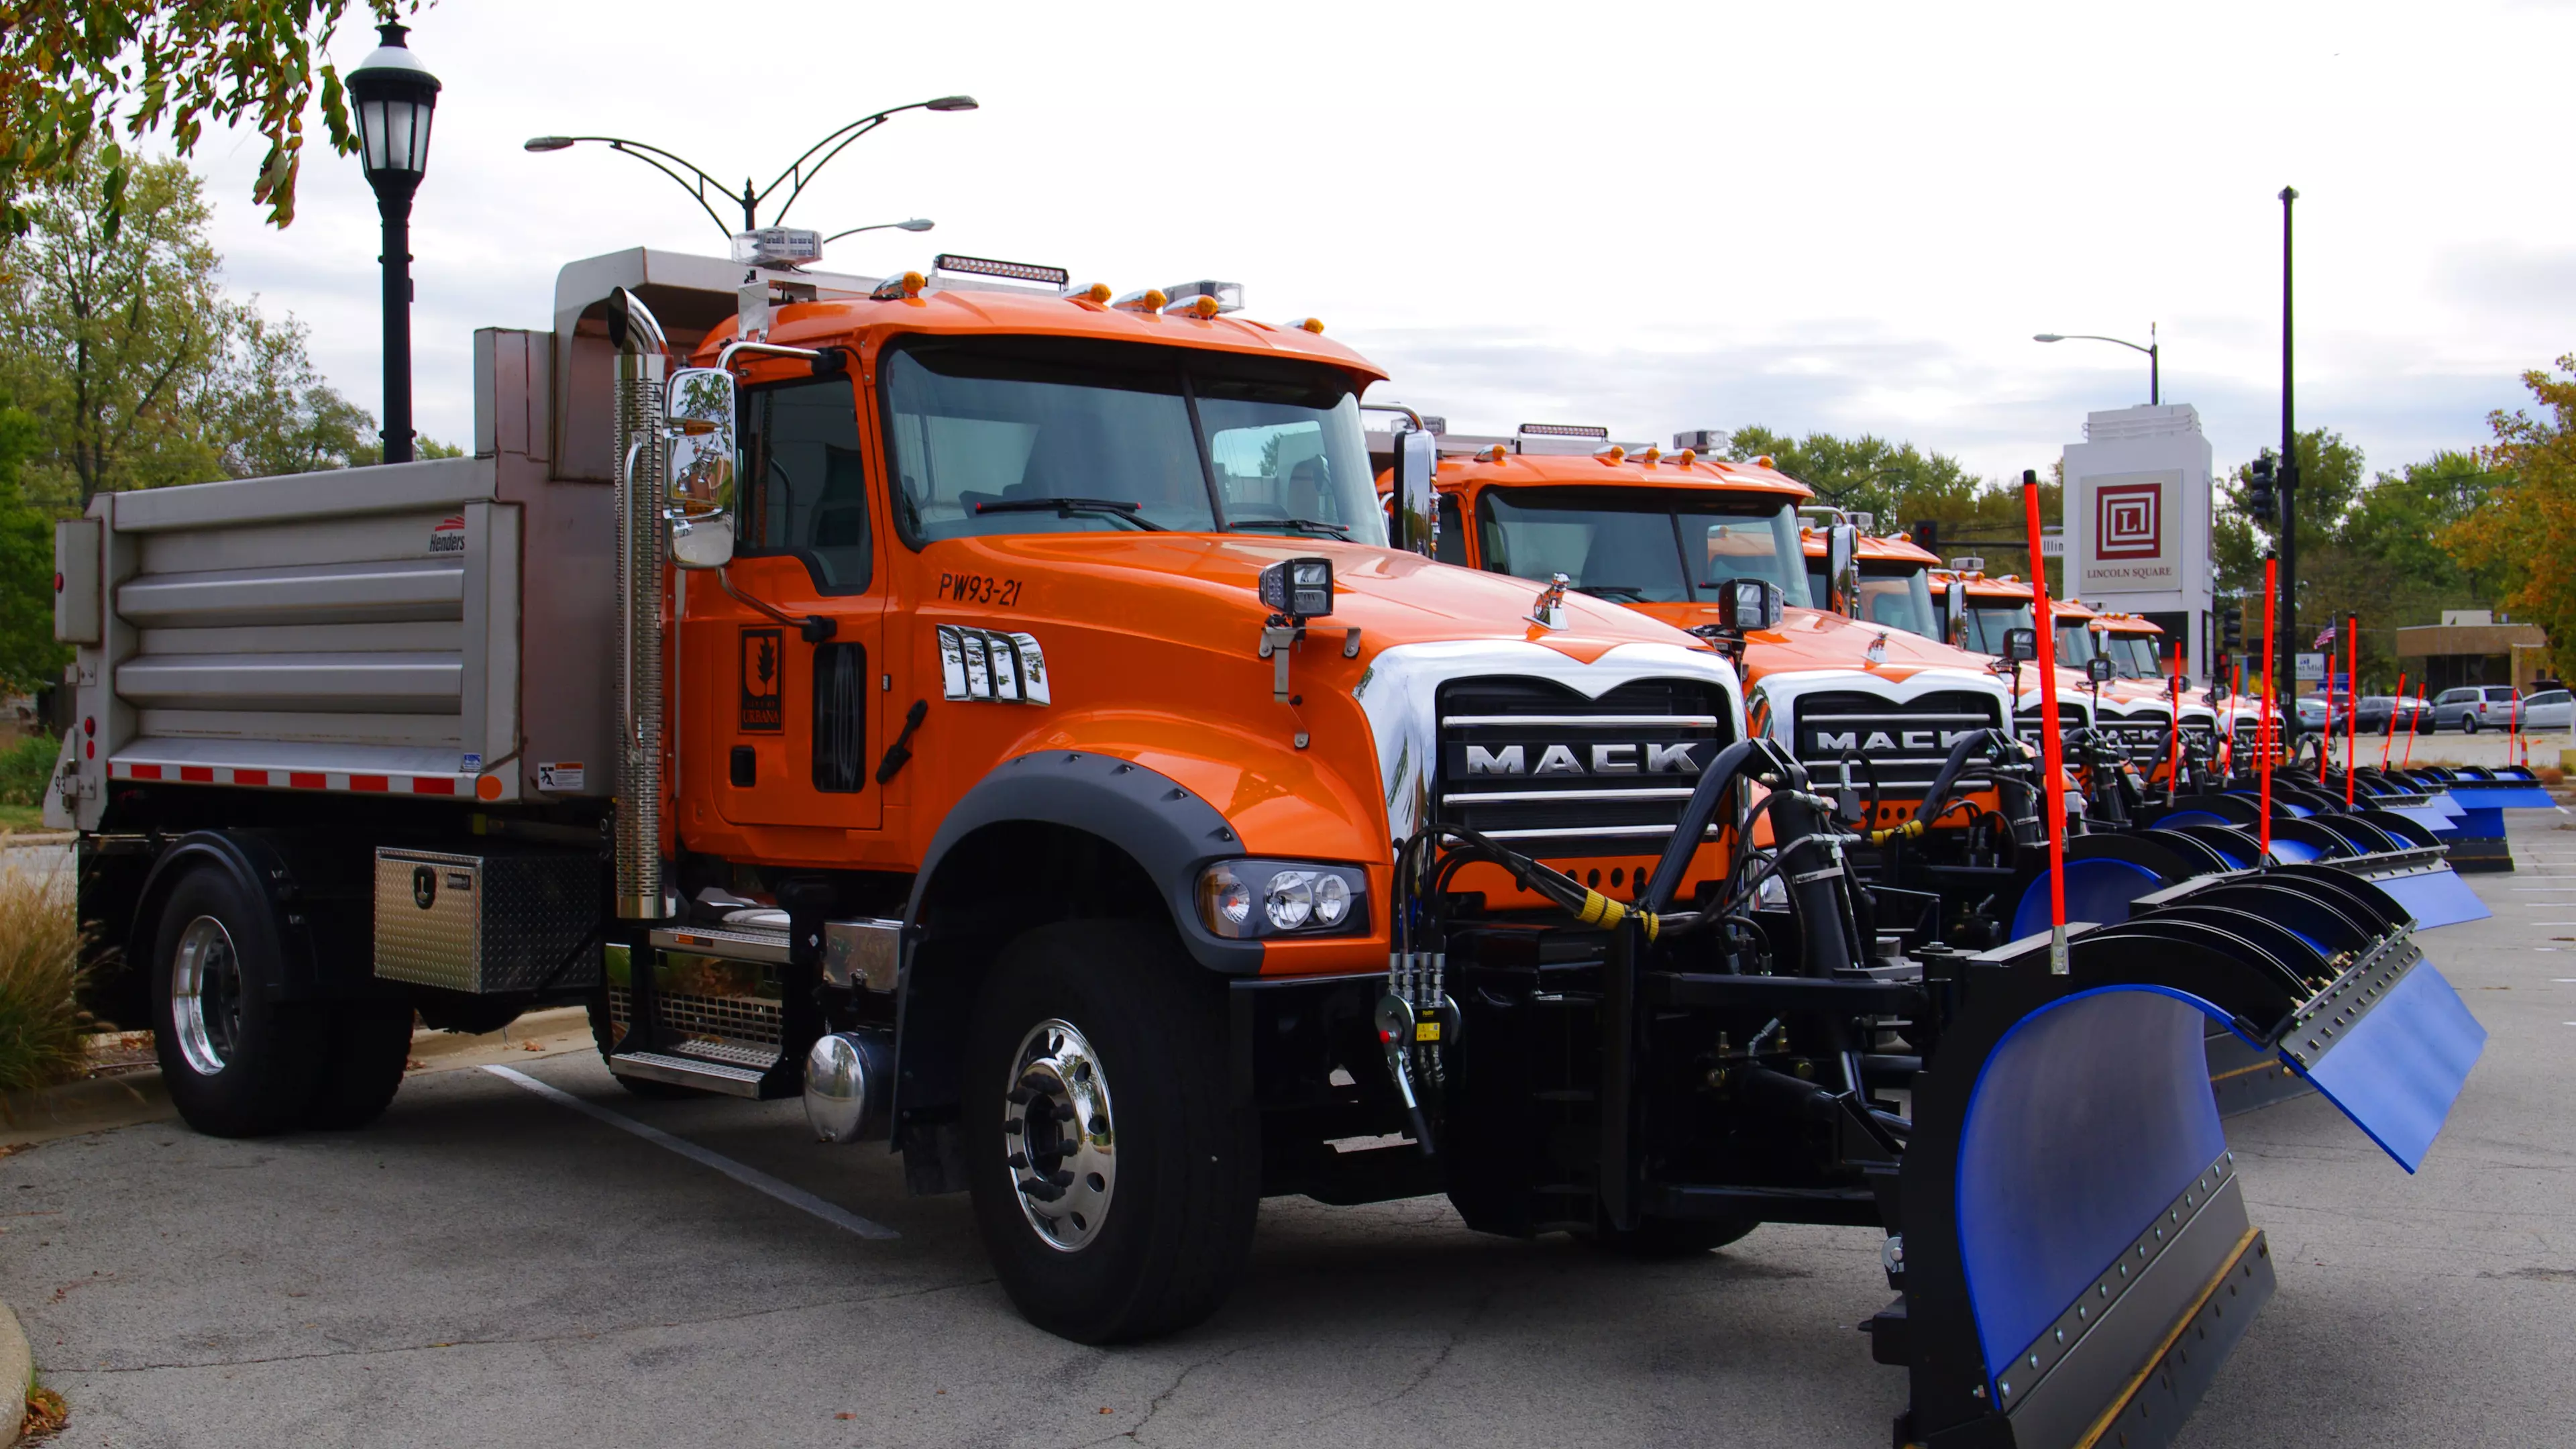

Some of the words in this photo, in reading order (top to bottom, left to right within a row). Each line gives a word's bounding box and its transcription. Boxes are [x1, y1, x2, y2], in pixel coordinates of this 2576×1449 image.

[429, 532, 465, 552] Henders
[2087, 568, 2130, 578] LINCOLN
[2132, 567, 2172, 579] SQUARE
[938, 573, 1022, 606] PW93-21
[742, 709, 780, 724] URBANA
[2106, 729, 2160, 741] ACK
[1466, 743, 1701, 775] MACK
[55, 775, 66, 795] 93
